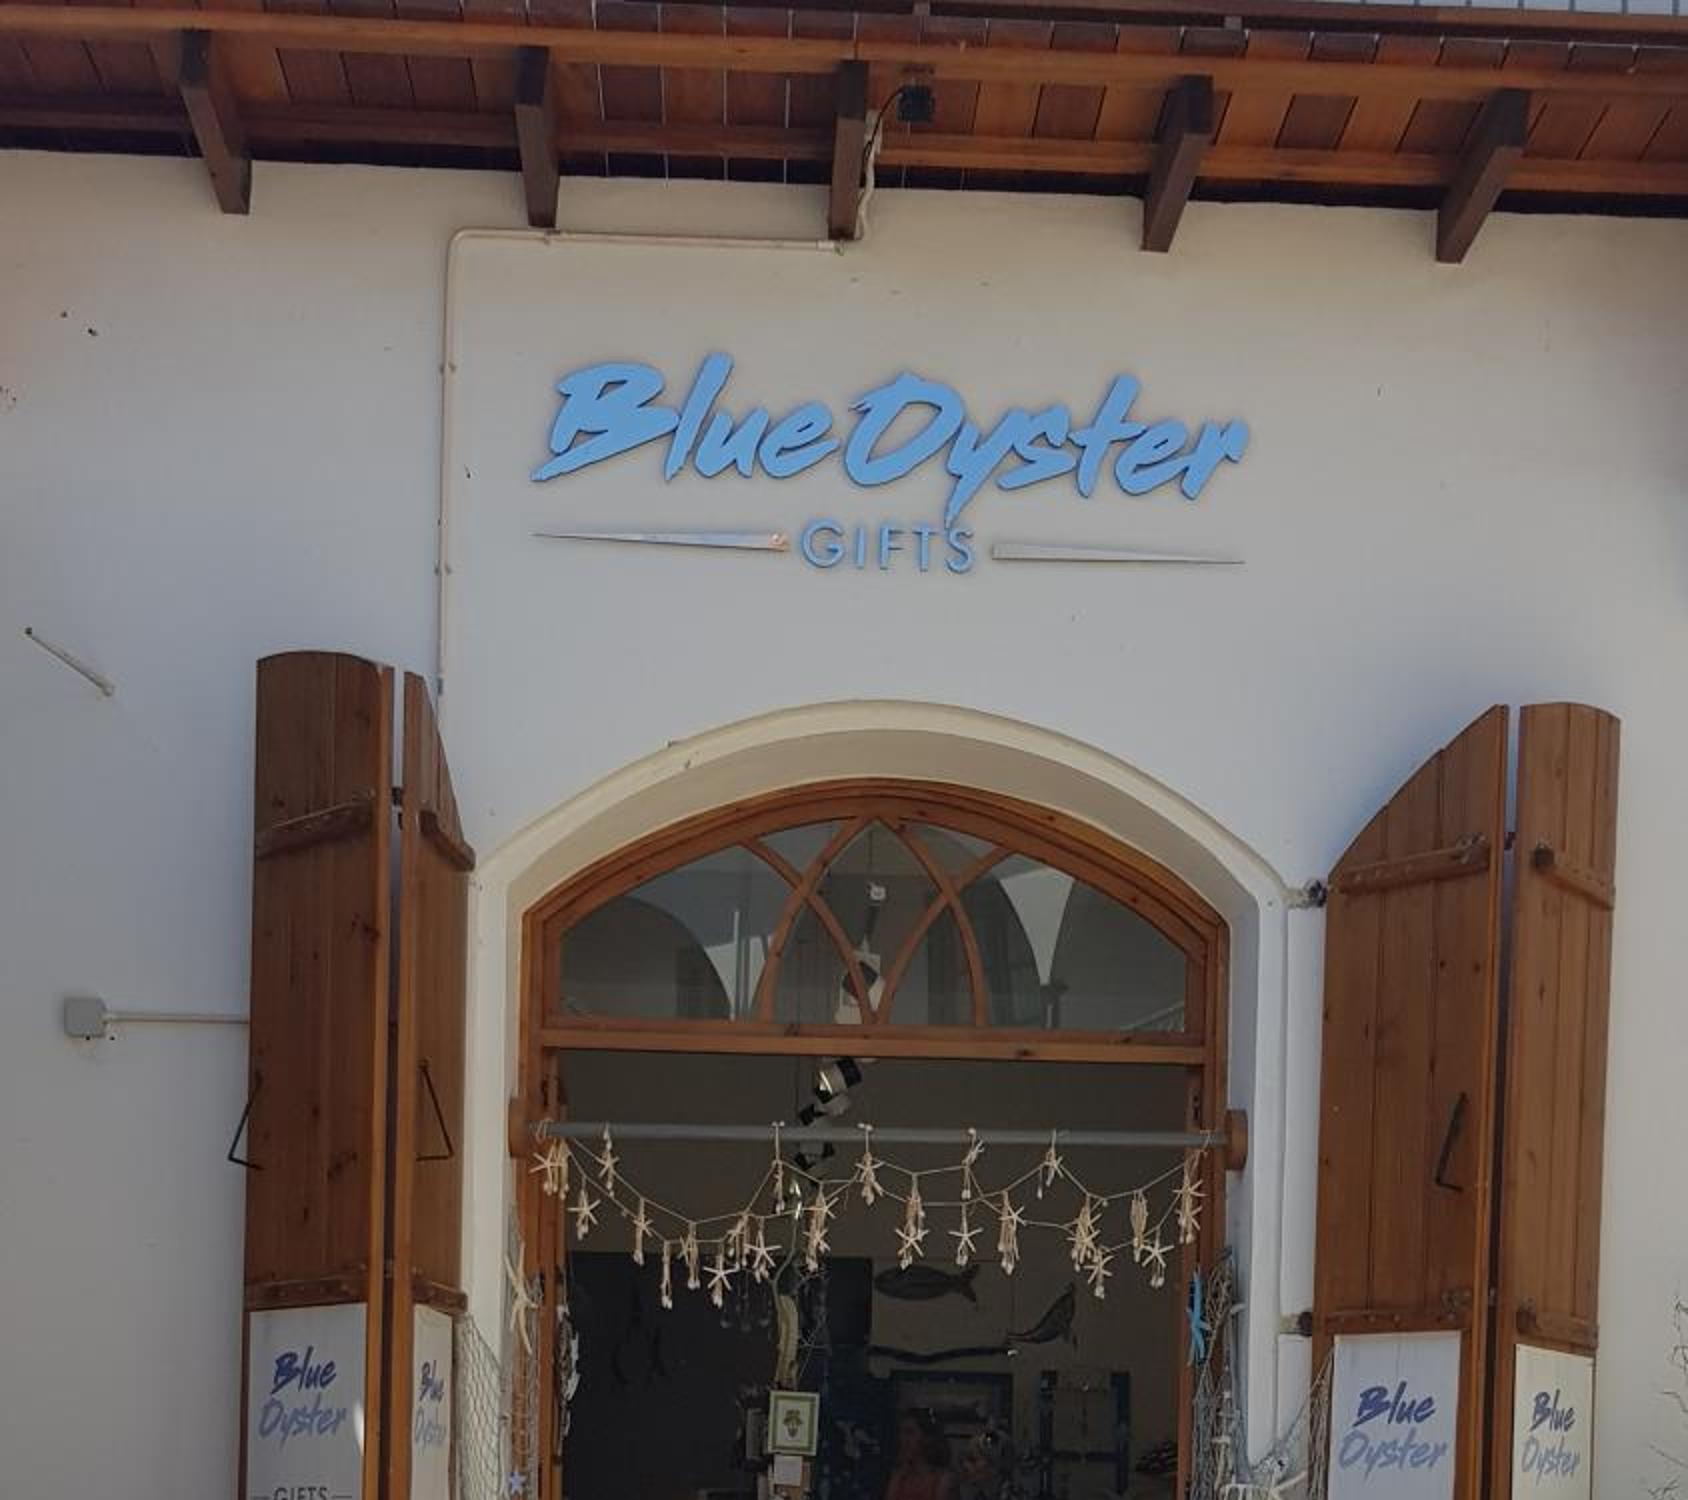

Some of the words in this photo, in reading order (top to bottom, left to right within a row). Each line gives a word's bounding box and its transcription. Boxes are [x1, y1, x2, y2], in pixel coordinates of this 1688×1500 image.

[530, 352, 841, 482] Blue
[844, 371, 1250, 530] Oyster
[801, 517, 975, 575] GIFTS
[271, 1345, 337, 1395] Blue
[258, 1393, 348, 1451] Oyster
[1352, 1381, 1437, 1428] Blue
[1530, 1388, 1576, 1433] Blue
[1338, 1428, 1448, 1481] Oyster
[1521, 1434, 1581, 1487] Oyster
